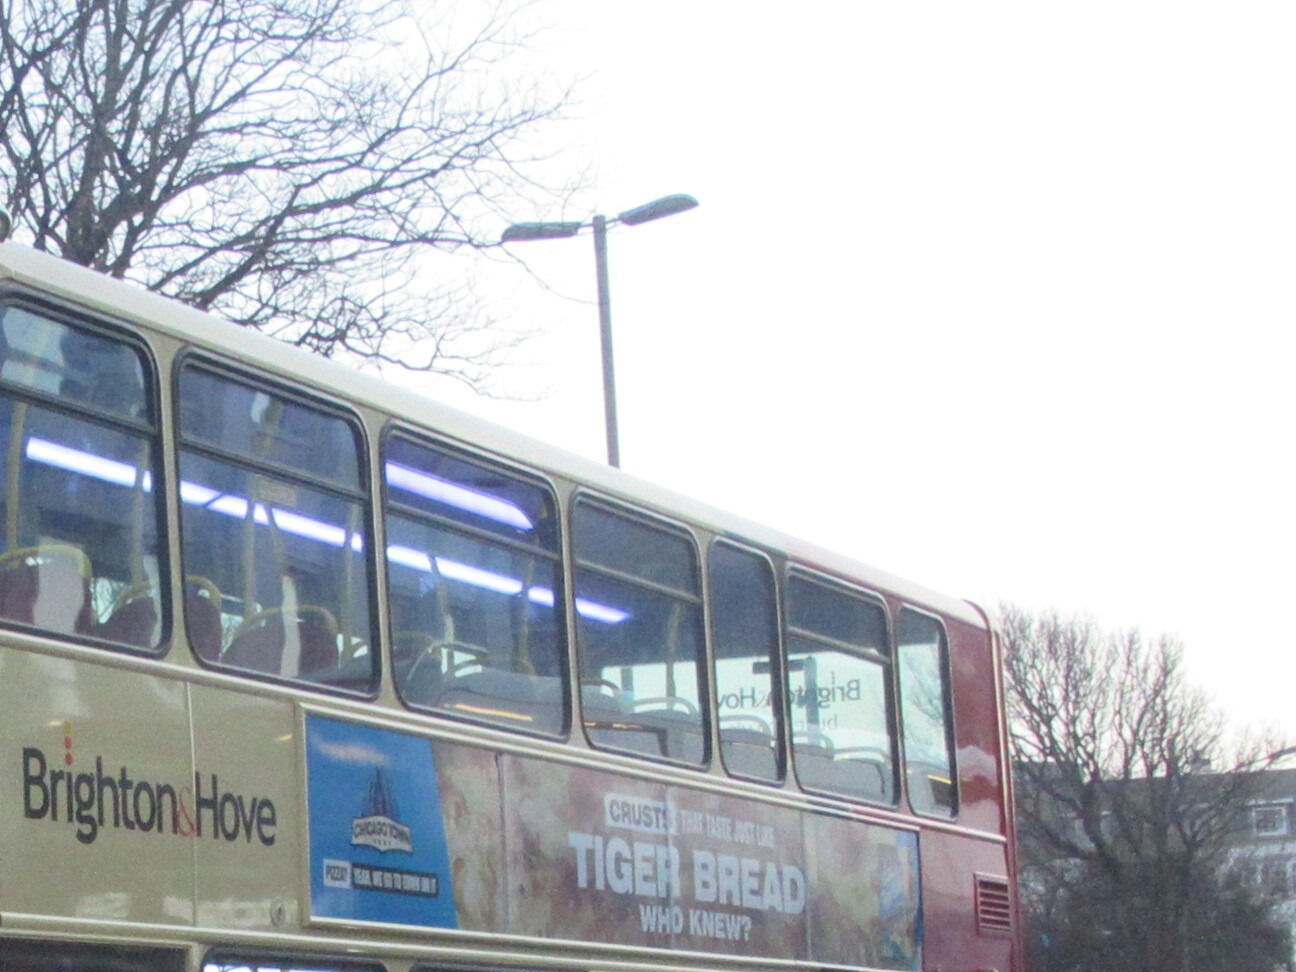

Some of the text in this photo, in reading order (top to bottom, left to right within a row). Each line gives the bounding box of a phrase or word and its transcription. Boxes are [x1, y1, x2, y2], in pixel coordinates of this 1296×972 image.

[609, 799, 673, 832] CRUSTS
[568, 830, 806, 915] TIGER BREAD
[639, 904, 751, 941] WHO KNEW?
